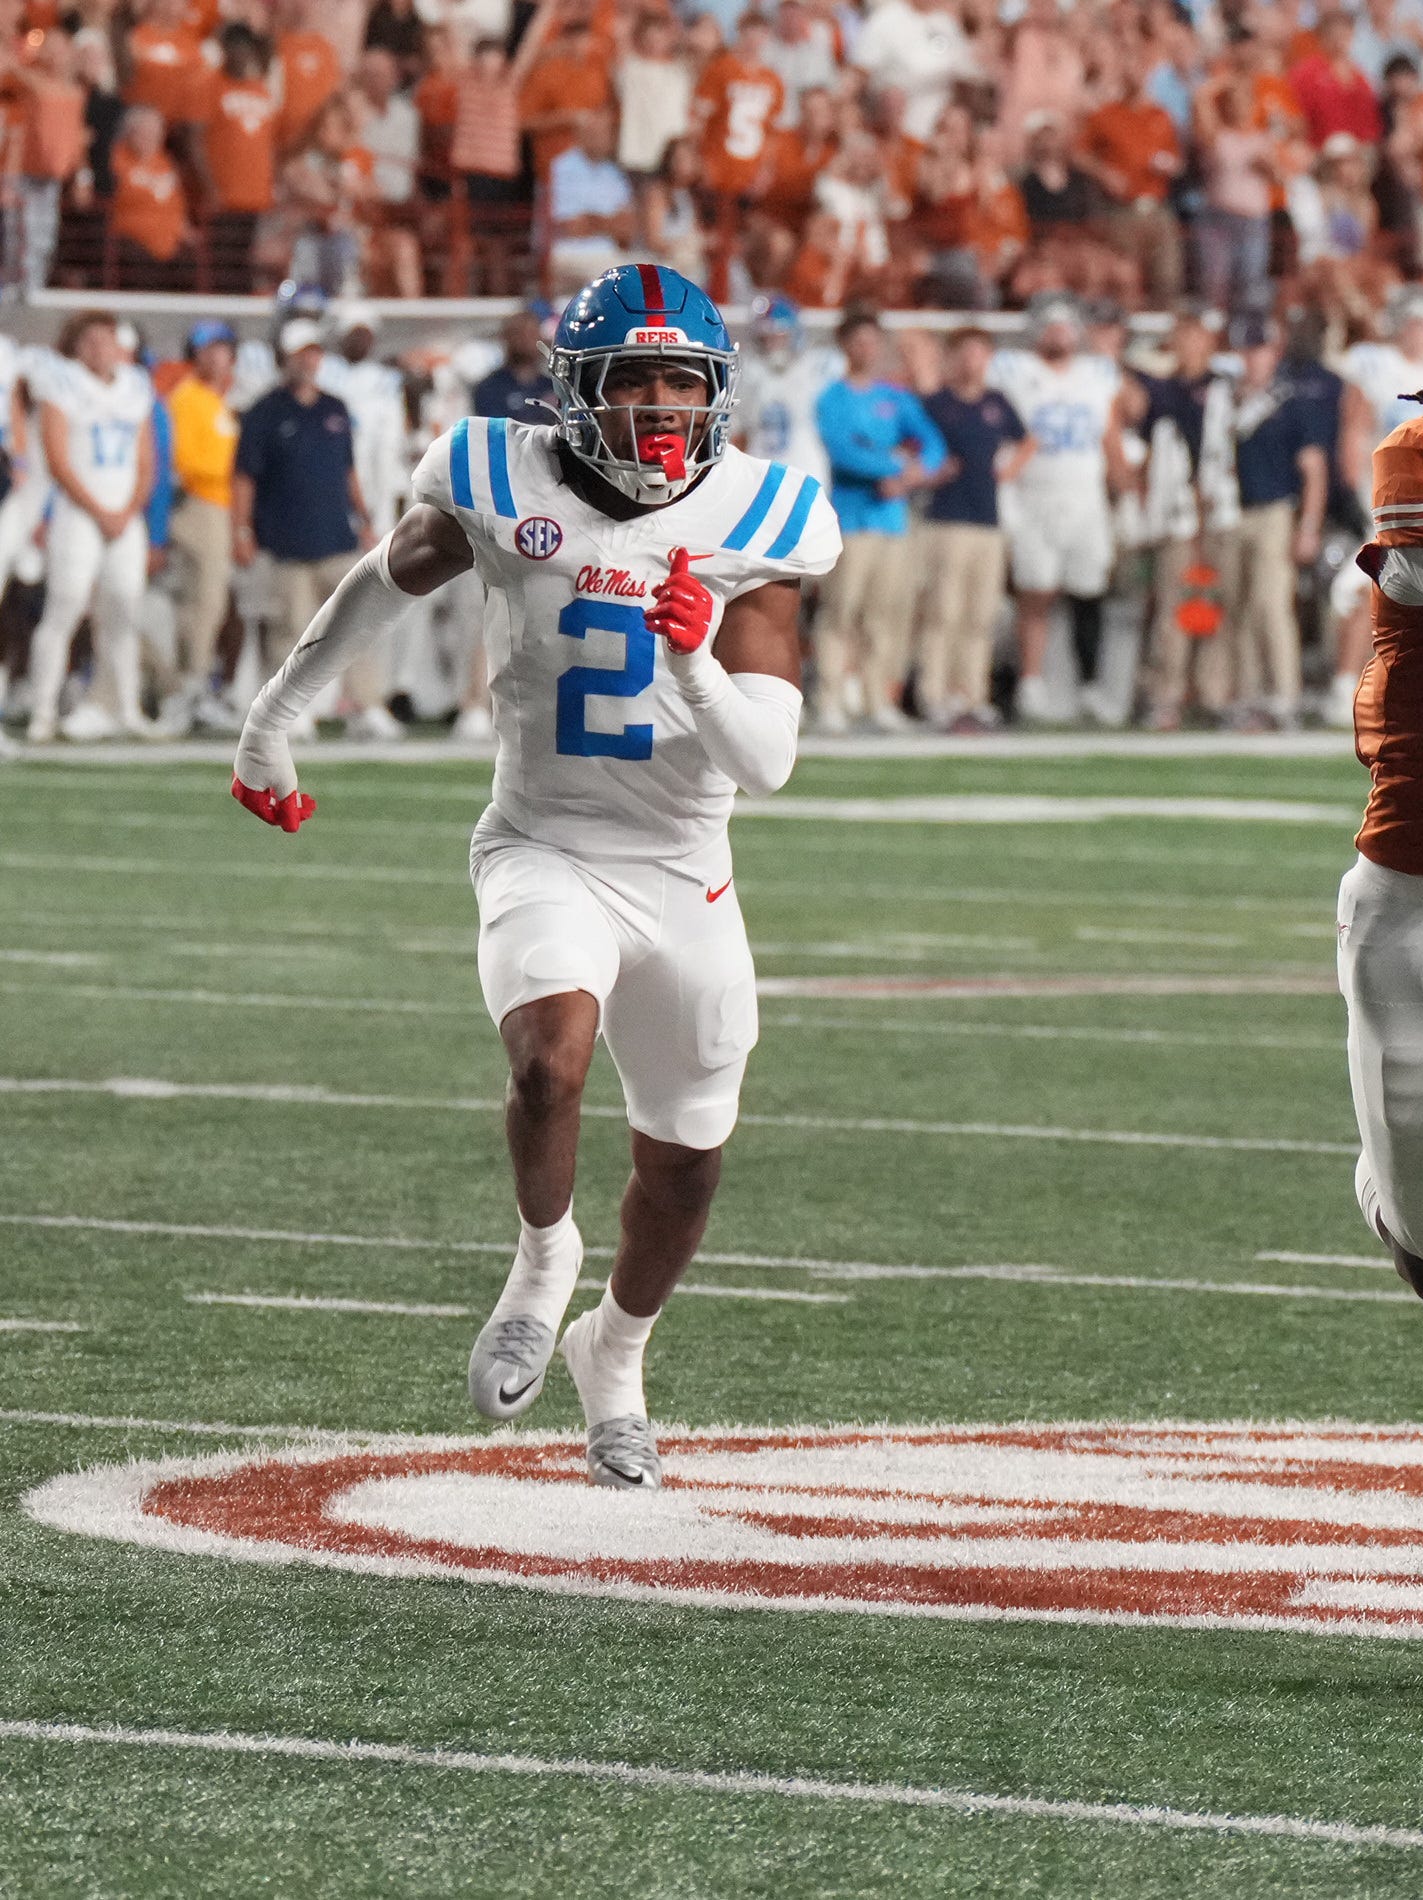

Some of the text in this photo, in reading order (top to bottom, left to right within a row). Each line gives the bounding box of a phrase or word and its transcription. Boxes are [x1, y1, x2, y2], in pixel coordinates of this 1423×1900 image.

[636, 331, 678, 343] REBS
[519, 518, 560, 558] SEC
[575, 564, 648, 598] Ole Miss
[555, 597, 656, 761] 2
